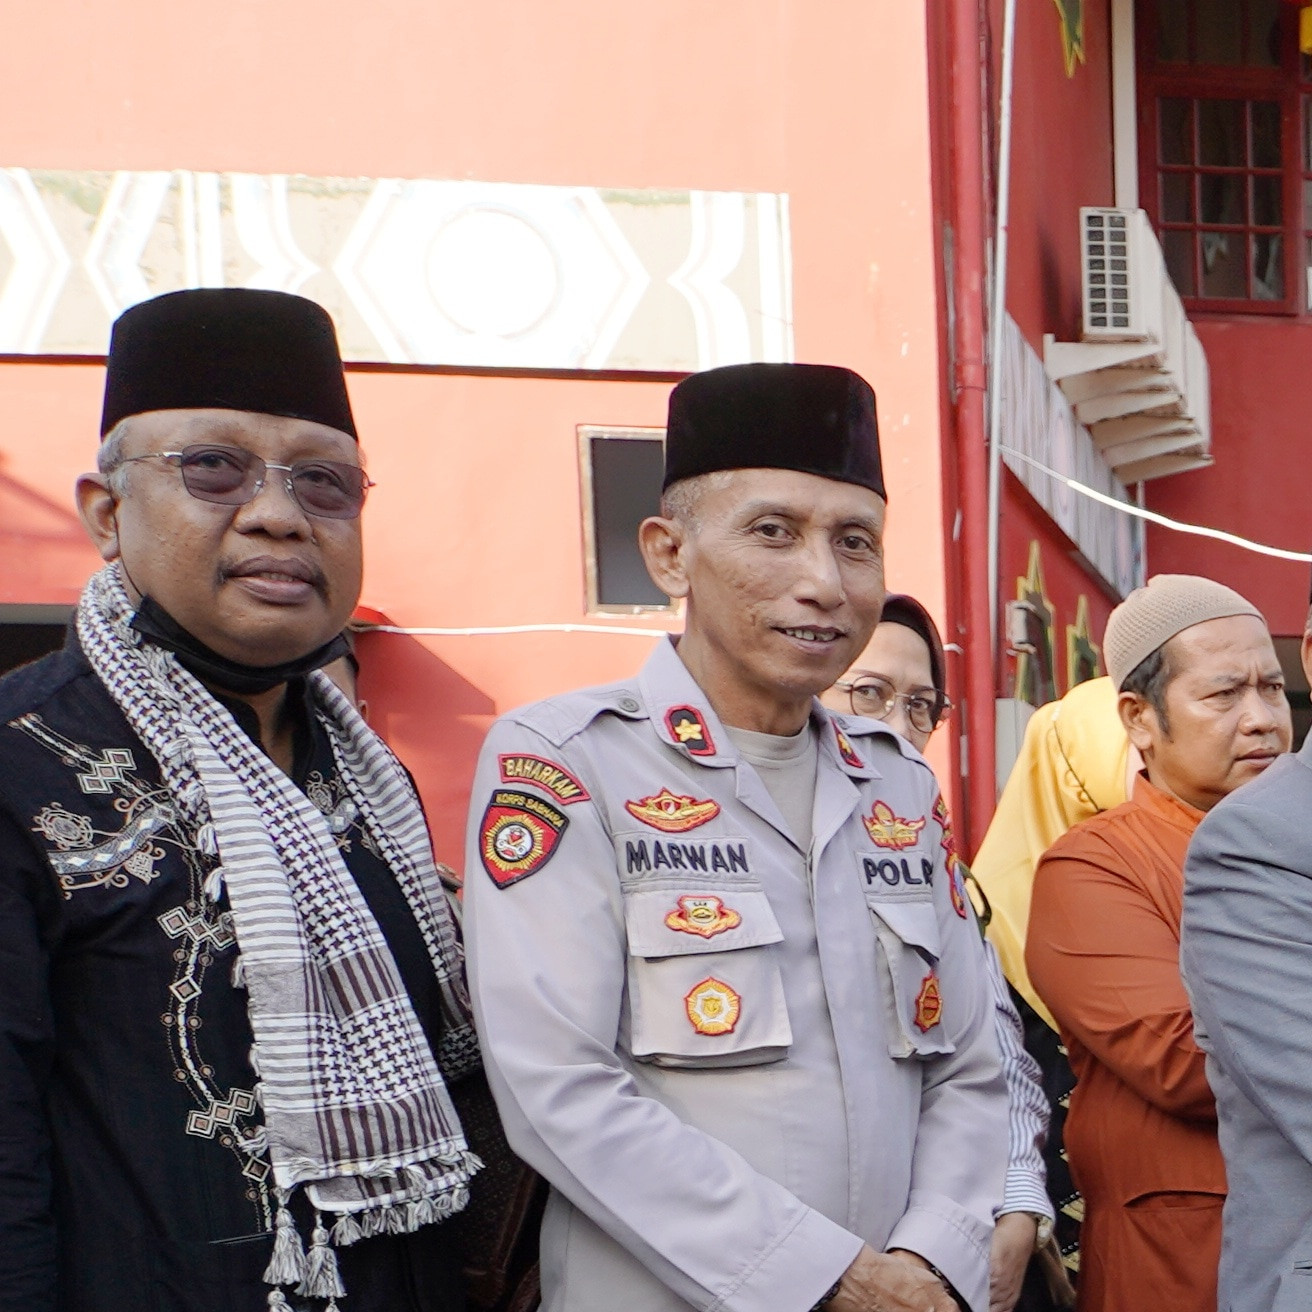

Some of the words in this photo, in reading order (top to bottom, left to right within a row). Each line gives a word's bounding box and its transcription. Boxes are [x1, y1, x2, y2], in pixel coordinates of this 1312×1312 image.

[502, 758, 582, 799] BAHARKAM
[626, 839, 749, 874] MARWAN
[863, 857, 934, 887] POLR
